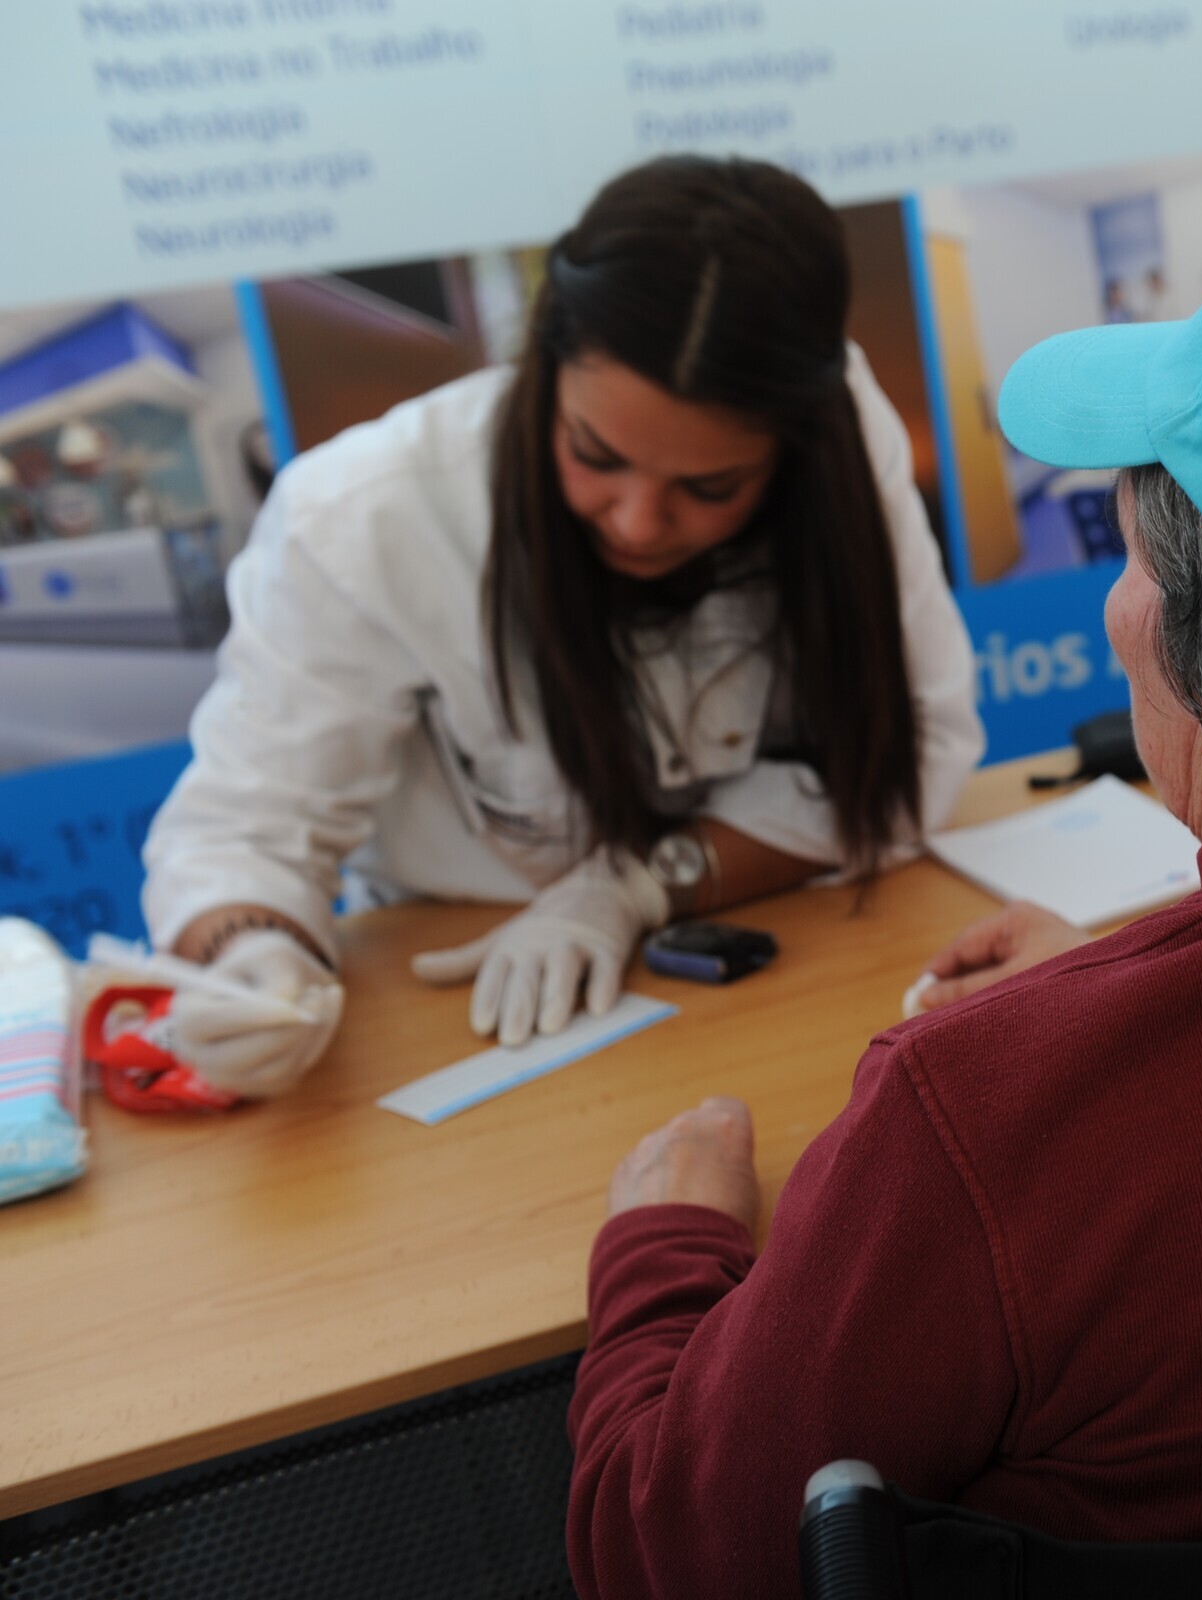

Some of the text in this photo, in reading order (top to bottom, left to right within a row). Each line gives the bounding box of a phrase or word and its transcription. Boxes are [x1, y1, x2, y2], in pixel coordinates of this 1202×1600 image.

[97, 51, 261, 94] Medicina
[328, 27, 480, 69] Trabalho
[628, 50, 832, 92] Pneumologia
[108, 105, 304, 149] Nefrologia
[122, 152, 373, 201] Neurocirurgia
[137, 210, 334, 255] Neurologia
